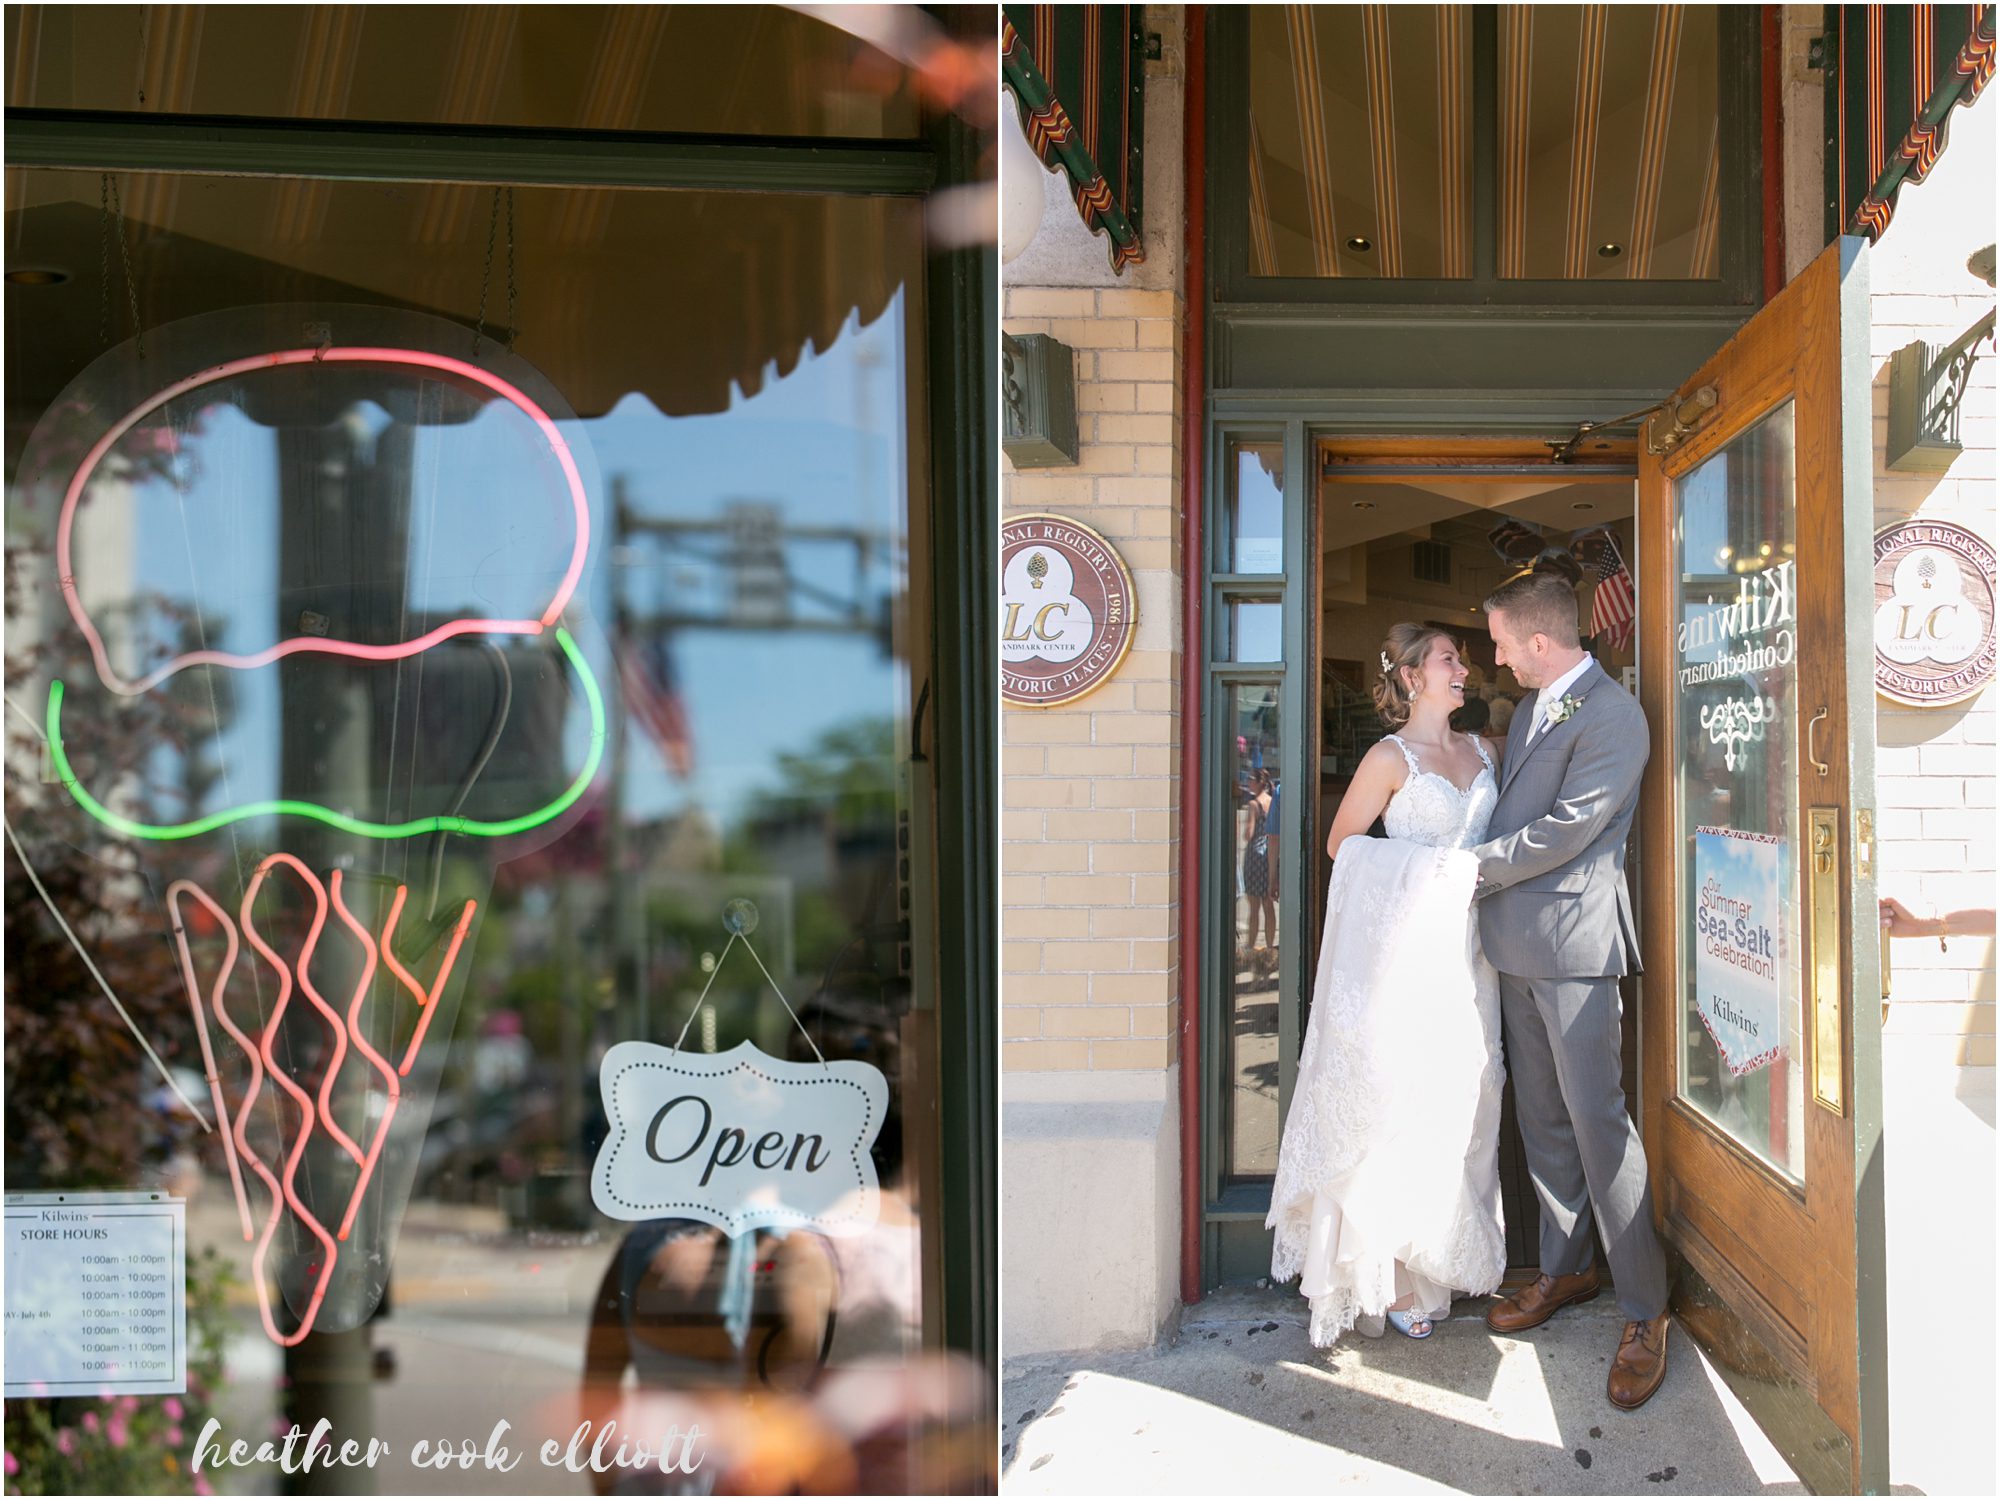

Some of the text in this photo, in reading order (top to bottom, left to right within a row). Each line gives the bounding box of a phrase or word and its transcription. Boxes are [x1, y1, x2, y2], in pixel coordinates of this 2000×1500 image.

[1043, 526, 1111, 574] REGISTRY
[1931, 528, 1996, 574] REGISTRY
[1108, 593, 1121, 623] 1986
[1002, 602, 1069, 641] LC
[1893, 604, 1958, 641] LC
[1044, 643, 1076, 651] CENTER
[1063, 641, 1112, 687] PLACES
[1876, 664, 1948, 693] HISTORIC
[1708, 877, 1721, 893] Our
[1701, 886, 1752, 921] Summer
[1698, 905, 1771, 958] Sea-Salt
[1706, 935, 1774, 981] Celebration!
[1713, 994, 1758, 1037] Kilwins
[645, 1095, 830, 1187] Open
[41, 1210, 90, 1222] Kilwins
[21, 1228, 108, 1240] STORE HOURS
[81, 1255, 119, 1264] 10:00am
[128, 1255, 166, 1265] 10:00pm
[81, 1273, 119, 1282] 10:00am
[128, 1273, 166, 1283] 10:00pm
[81, 1291, 119, 1300] 10:00am
[128, 1290, 166, 1300] 10:00pm
[4, 1311, 19, 1319] AY-
[21, 1310, 36, 1320] July
[81, 1309, 119, 1318] 10:00am
[128, 1308, 166, 1317] 10:00pm
[81, 1326, 119, 1335] 10:00am
[128, 1325, 166, 1335] 10:00pm
[81, 1344, 119, 1353] 10:00am
[128, 1343, 166, 1352] 11:00pm
[81, 1361, 119, 1370] 10:00am
[128, 1360, 166, 1370] 11:00pm
